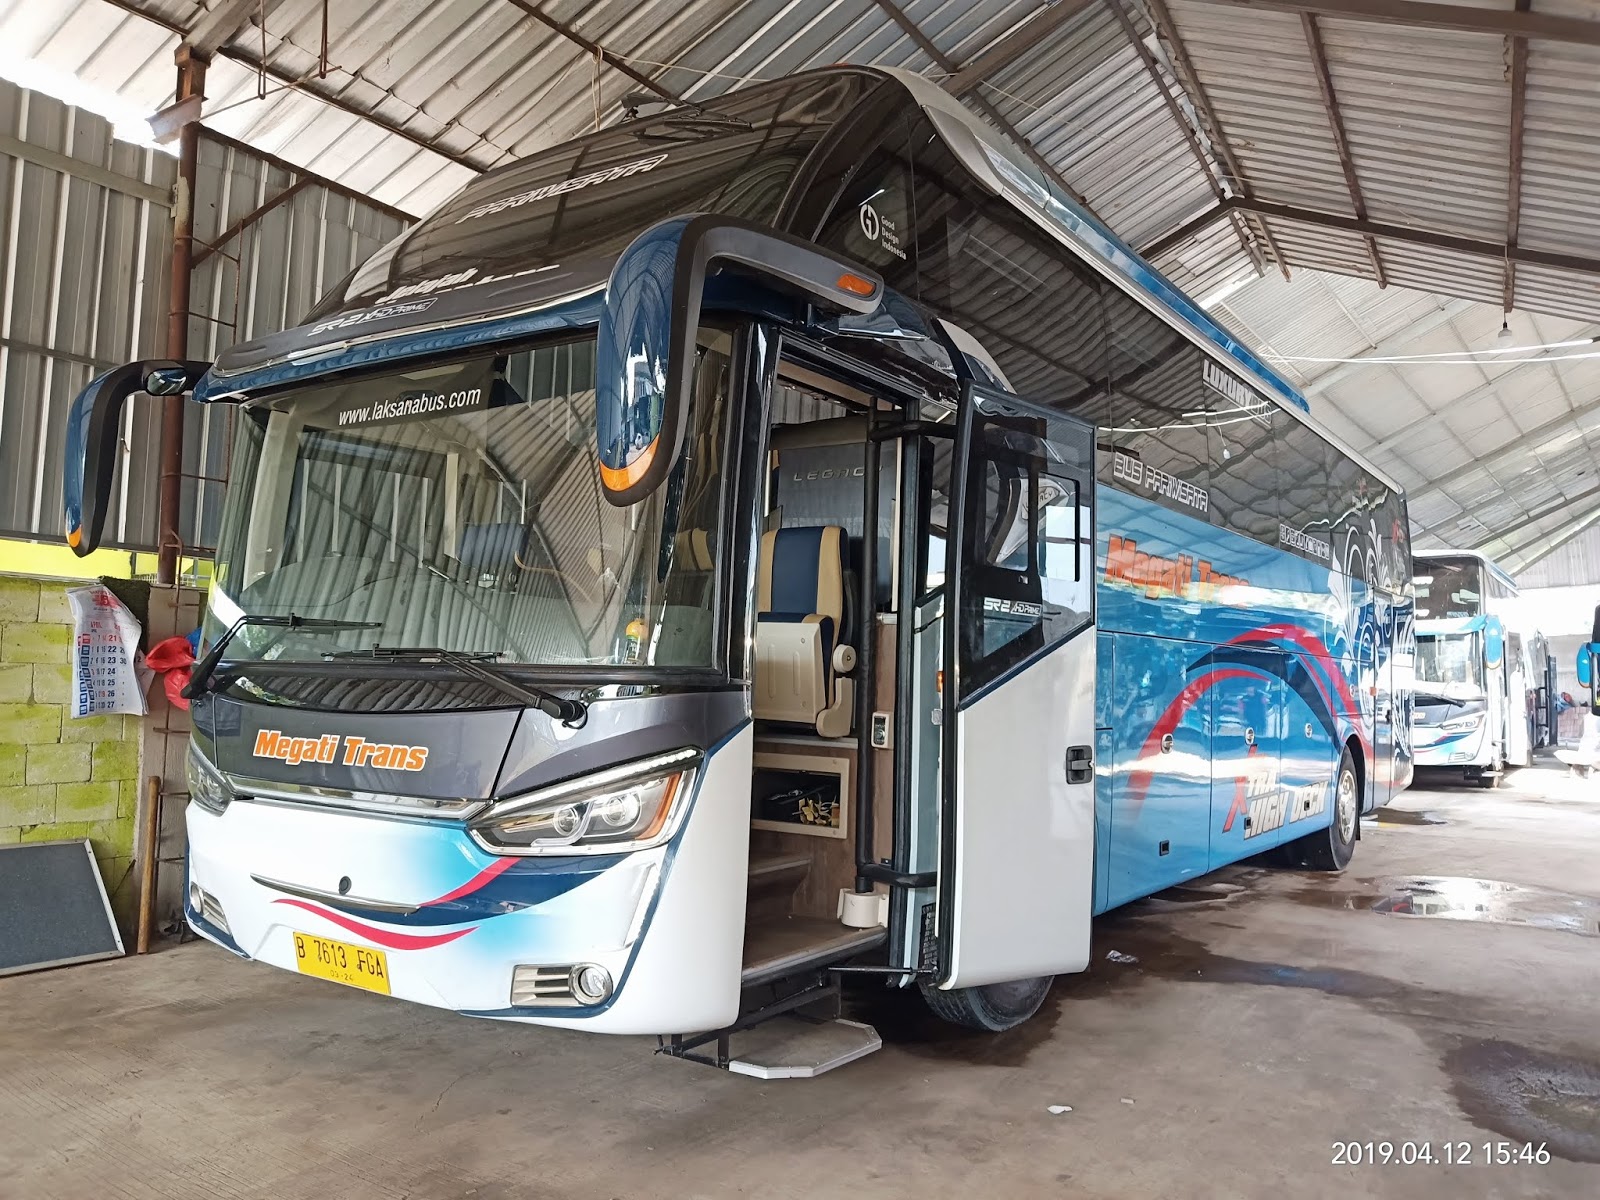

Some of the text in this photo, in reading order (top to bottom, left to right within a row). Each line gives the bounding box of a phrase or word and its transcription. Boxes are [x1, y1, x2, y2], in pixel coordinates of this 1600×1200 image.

[881, 215, 895, 230] Good
[882, 227, 899, 244] Design
[882, 239, 906, 260] Indonesia
[1203, 359, 1253, 407] LUXURY
[338, 388, 481, 426] www.laksanabus.com
[1113, 451, 1144, 485] BUS
[1104, 533, 1194, 600] Megati
[108, 634, 117, 642] 21
[253, 729, 429, 772] Megati Trans
[1244, 788, 1290, 840] HIGH
[296, 936, 384, 979] B 7613 FGA
